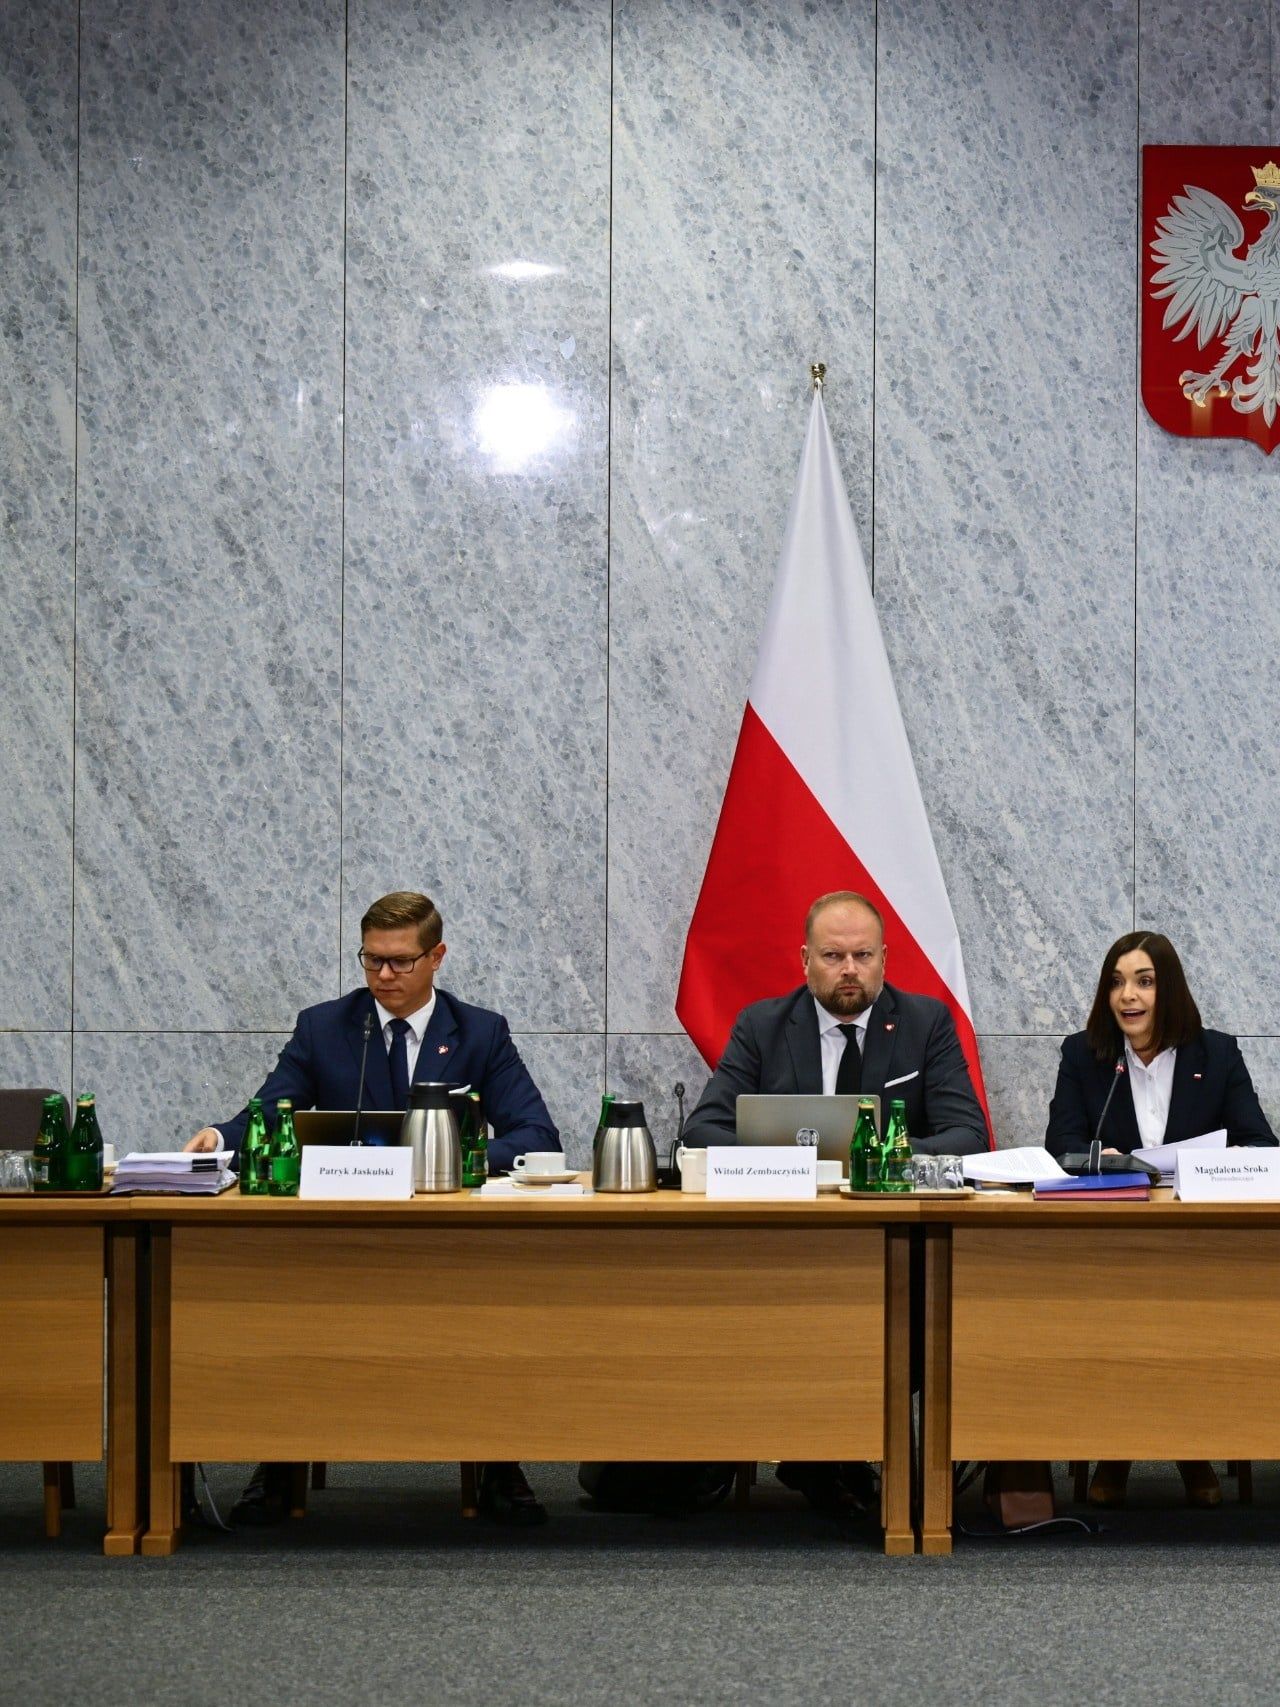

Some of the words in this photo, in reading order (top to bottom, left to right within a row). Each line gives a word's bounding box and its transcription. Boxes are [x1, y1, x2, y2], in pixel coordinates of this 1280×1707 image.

[319, 1167, 349, 1177] Patryk
[352, 1167, 394, 1176] Jaskulski
[714, 1167, 744, 1175] Witold
[746, 1166, 810, 1177] Zembaczyński
[1195, 1166, 1241, 1175] Magdalena
[1243, 1165, 1268, 1173] Sroka
